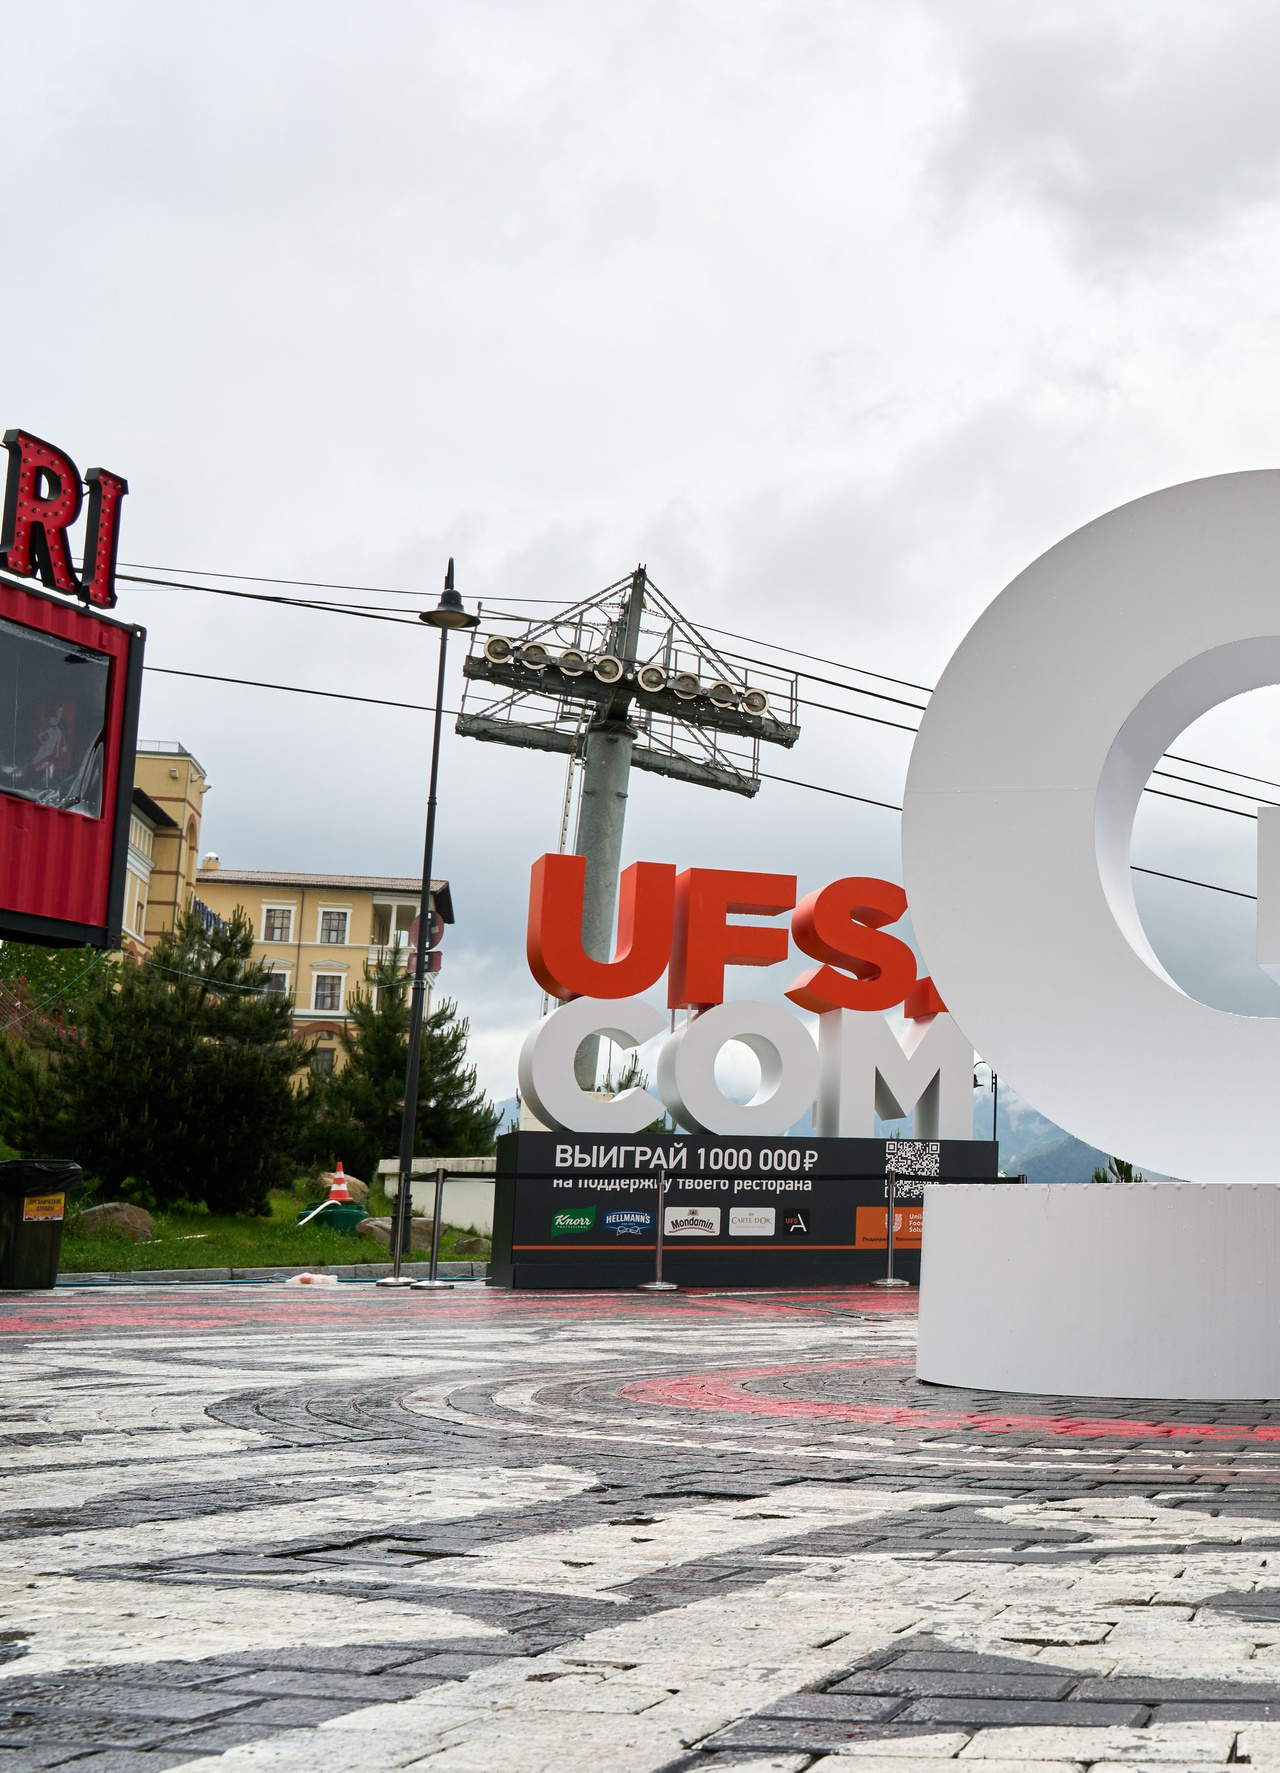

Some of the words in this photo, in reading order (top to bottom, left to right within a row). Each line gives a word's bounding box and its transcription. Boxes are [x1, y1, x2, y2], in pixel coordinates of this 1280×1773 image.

[518, 996, 974, 1140] COM
[555, 1142, 688, 1169] ВЫИГРАЙ
[697, 1148, 752, 1170] 1000
[677, 1178, 729, 1190] твоего
[733, 1179, 812, 1194] ресторана
[554, 1214, 592, 1226] Knorr
[605, 1213, 651, 1224] HELLMANN'S
[670, 1216, 714, 1230] Mondamin
[731, 1216, 752, 1225] CARTE
